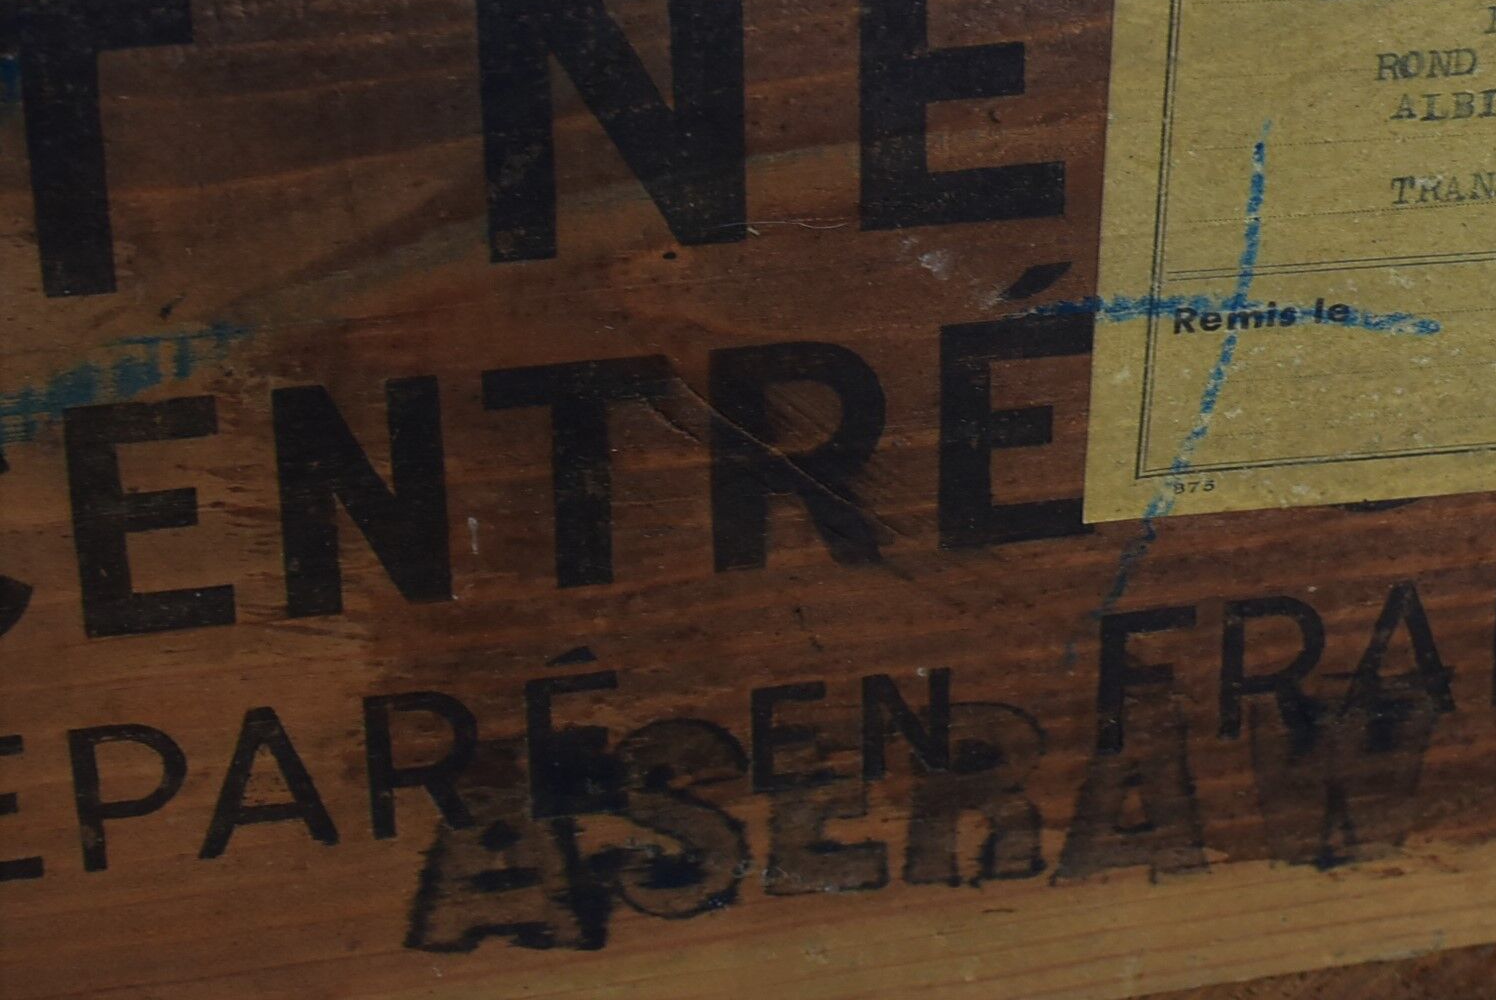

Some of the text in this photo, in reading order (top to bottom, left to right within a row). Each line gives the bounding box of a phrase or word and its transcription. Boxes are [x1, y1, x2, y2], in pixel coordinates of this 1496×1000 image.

[1375, 48, 1478, 81] ROND
[1172, 298, 1351, 335] Remis le
[0, 261, 1097, 640] ENTRÉ
[751, 667, 951, 794] EN
